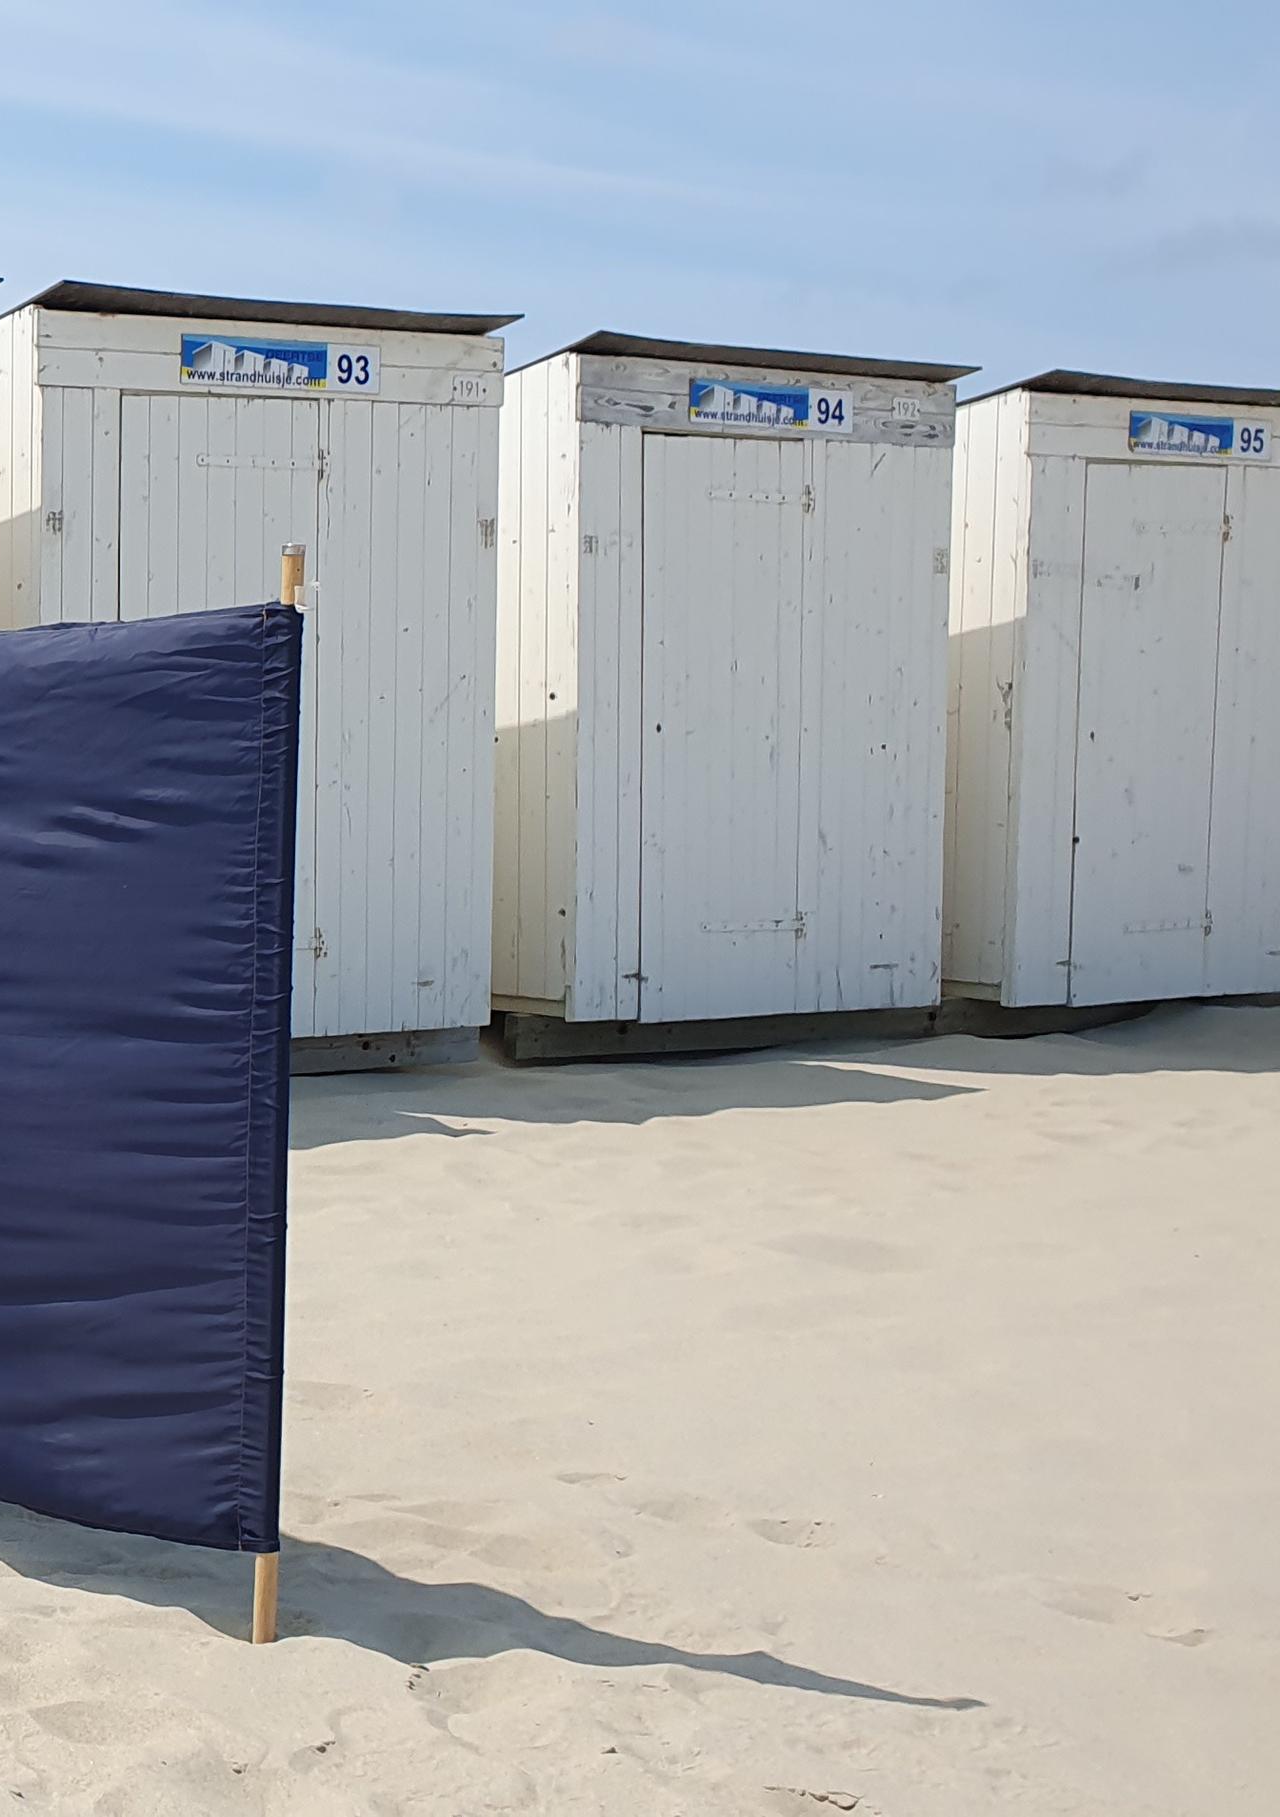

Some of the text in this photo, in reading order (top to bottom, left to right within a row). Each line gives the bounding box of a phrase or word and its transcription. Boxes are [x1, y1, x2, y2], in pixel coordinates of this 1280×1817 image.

[186, 368, 321, 388] www.strandhuisje.com
[337, 354, 370, 385] 93
[460, 380, 479, 398] 191
[817, 397, 845, 426] 94
[897, 401, 917, 418] 192
[1240, 427, 1265, 453] 95
